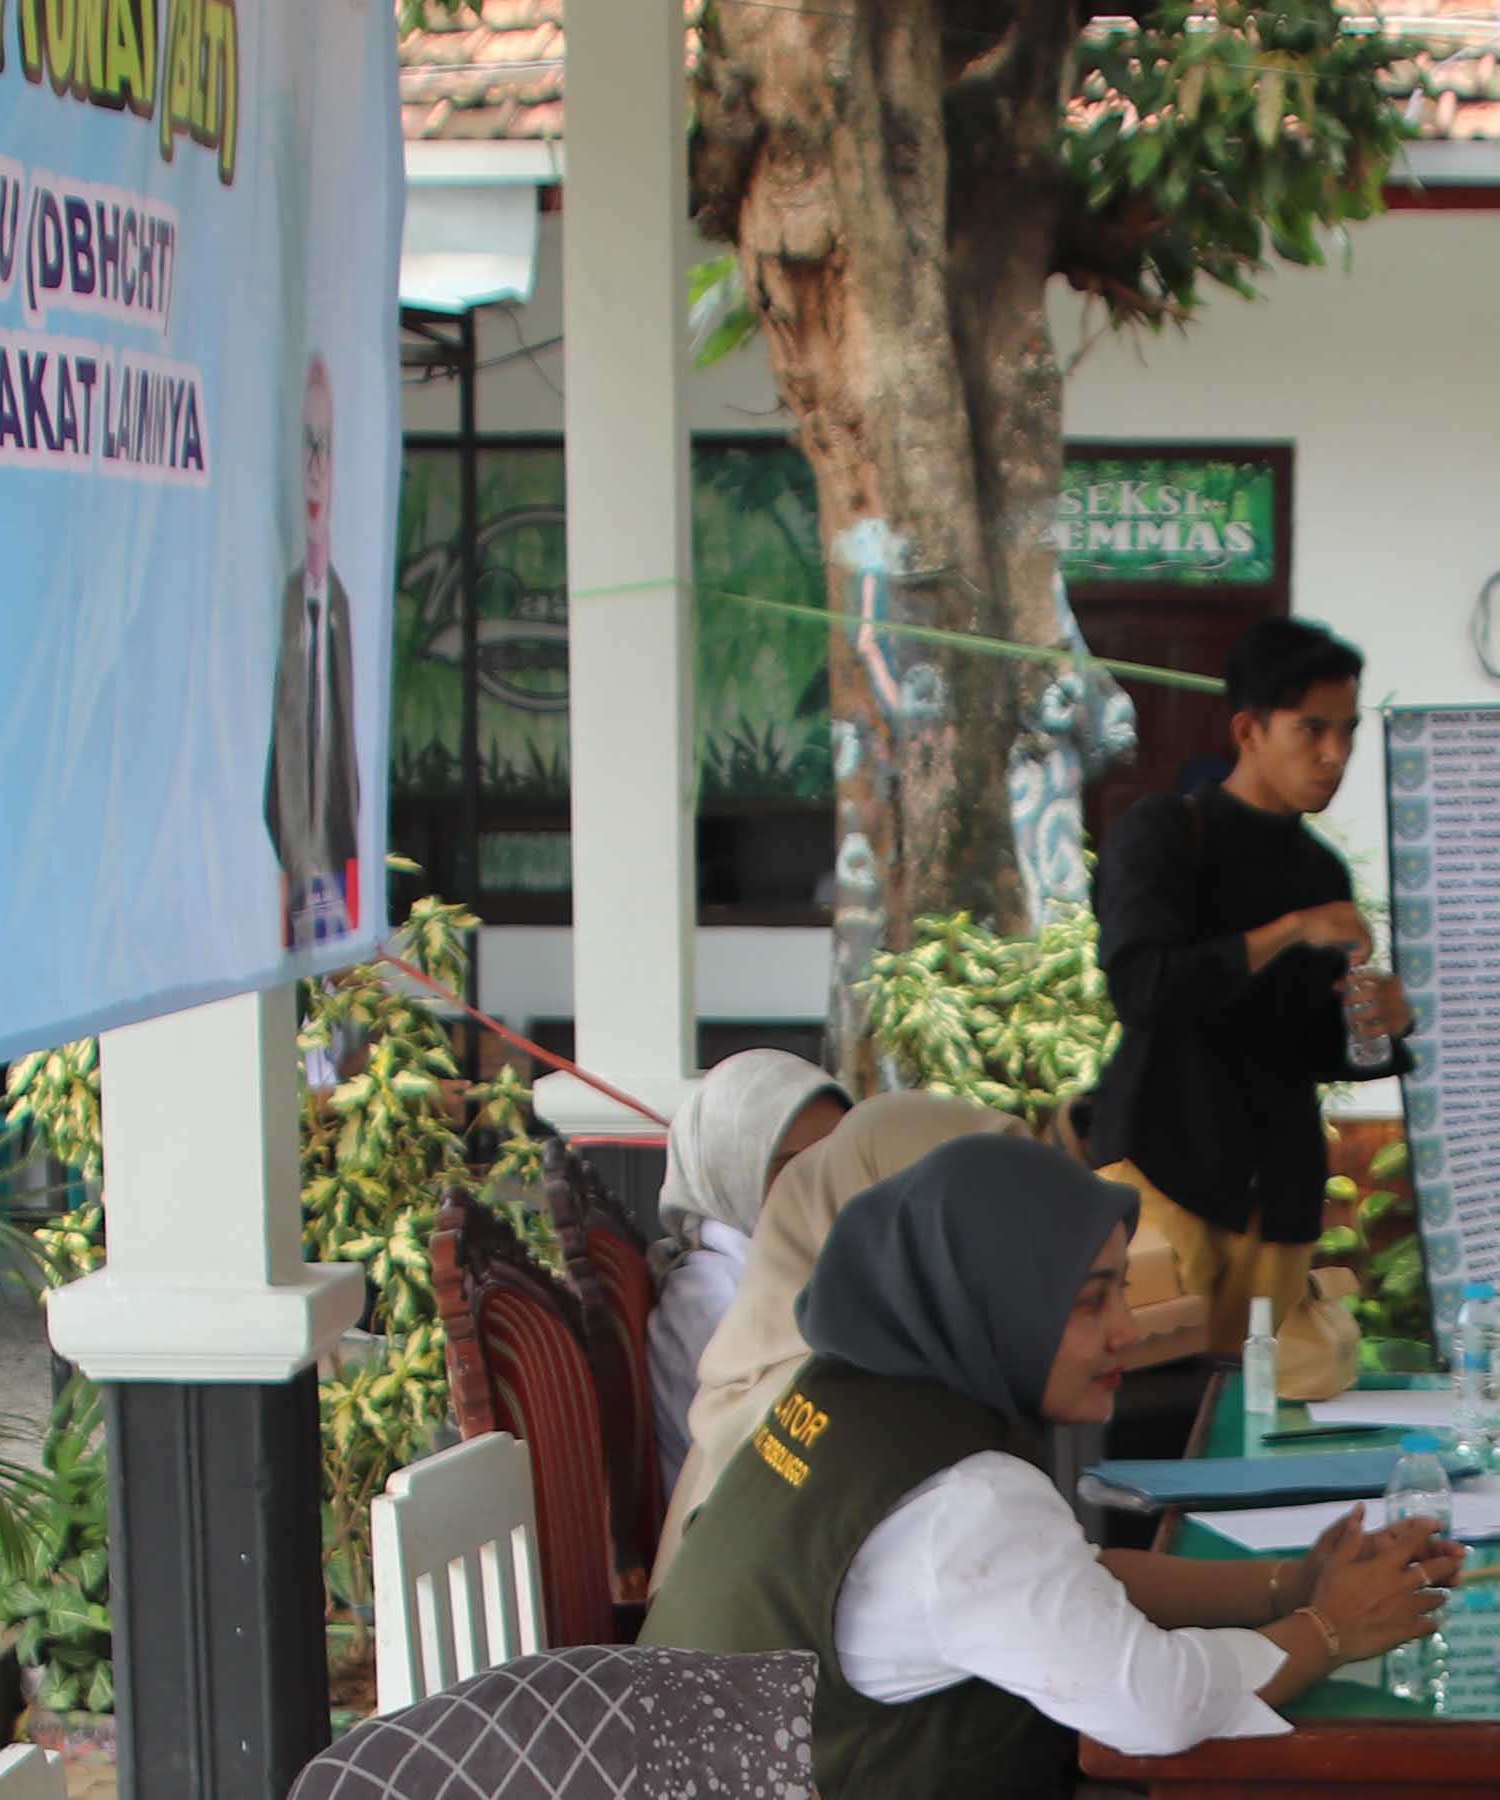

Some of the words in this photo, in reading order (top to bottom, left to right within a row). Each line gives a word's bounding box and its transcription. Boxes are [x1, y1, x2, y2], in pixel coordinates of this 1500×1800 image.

[25, 185, 176, 337] (DBHCHT)
[101, 361, 205, 471] LAINNYA
[1057, 479, 1204, 516] SEKSI
